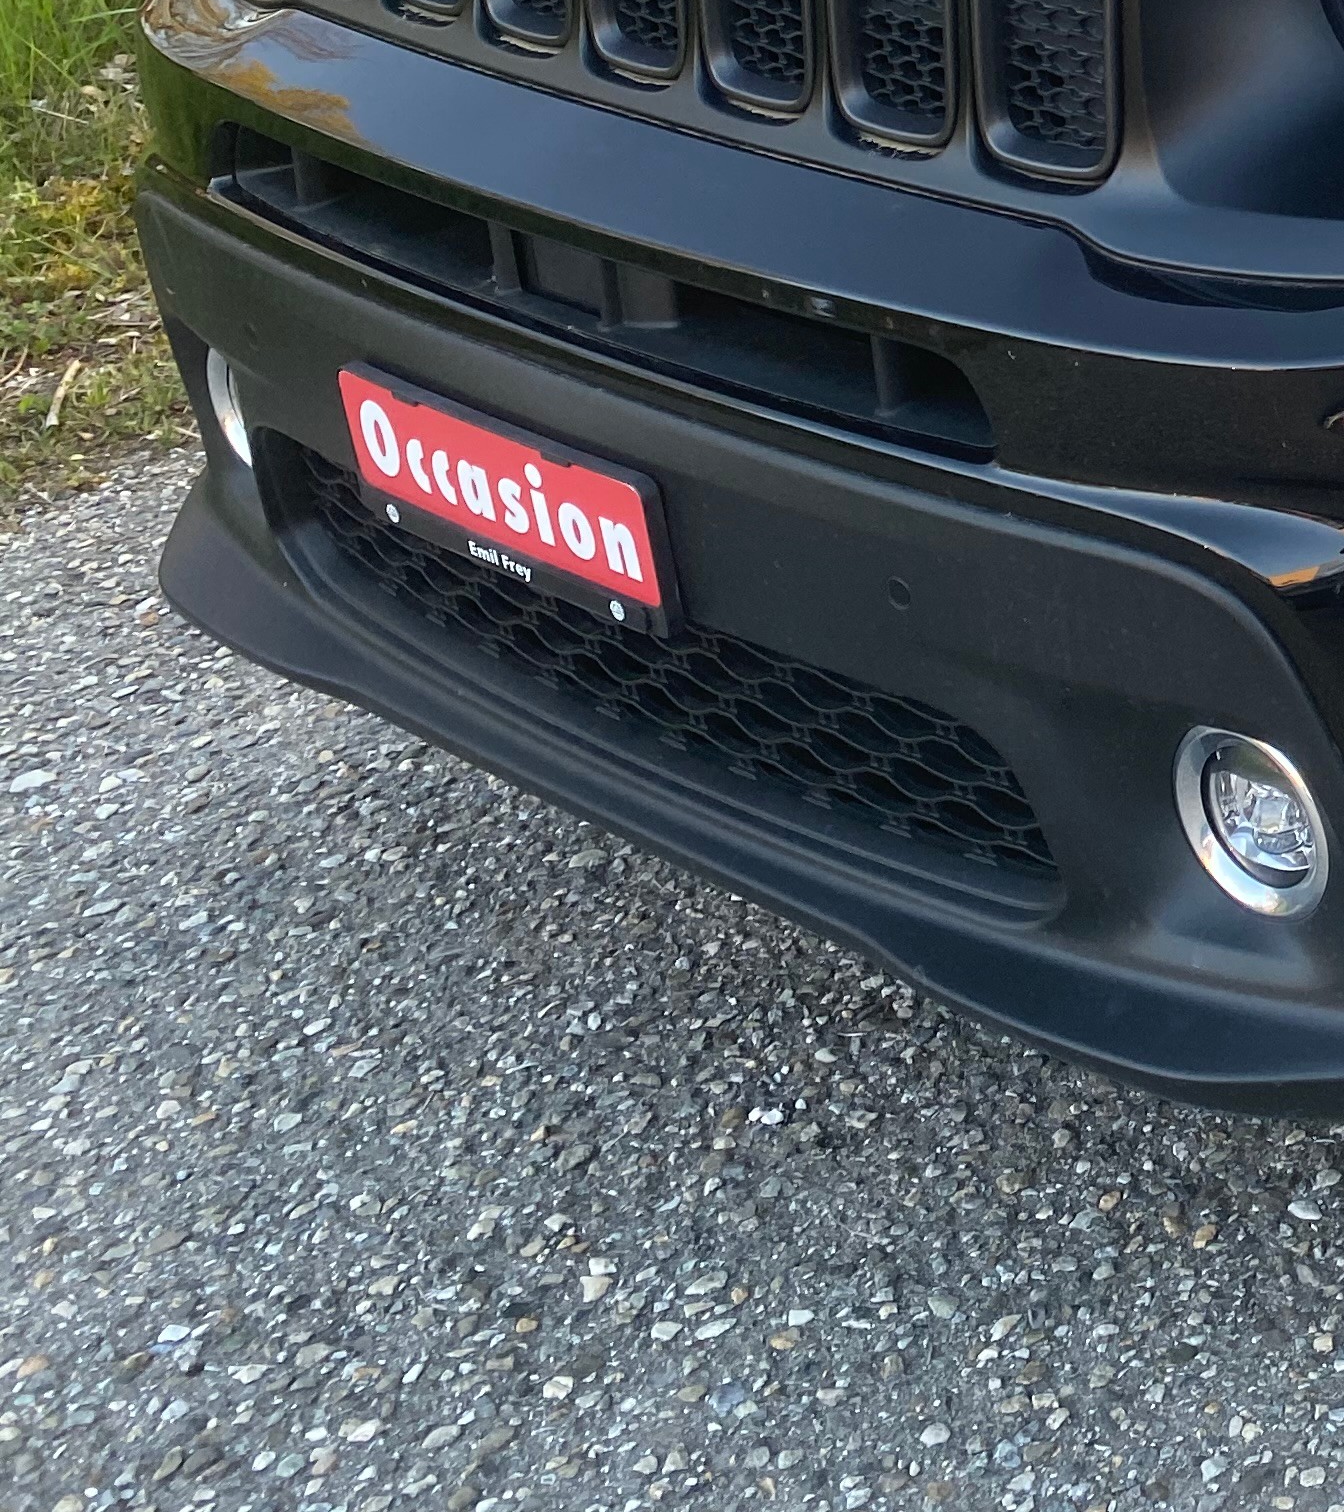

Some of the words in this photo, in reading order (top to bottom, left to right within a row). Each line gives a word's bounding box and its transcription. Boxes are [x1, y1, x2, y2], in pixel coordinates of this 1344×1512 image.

[359, 398, 644, 583] Occasion
[467, 539, 500, 567] Emil
[500, 554, 532, 583] Frey
